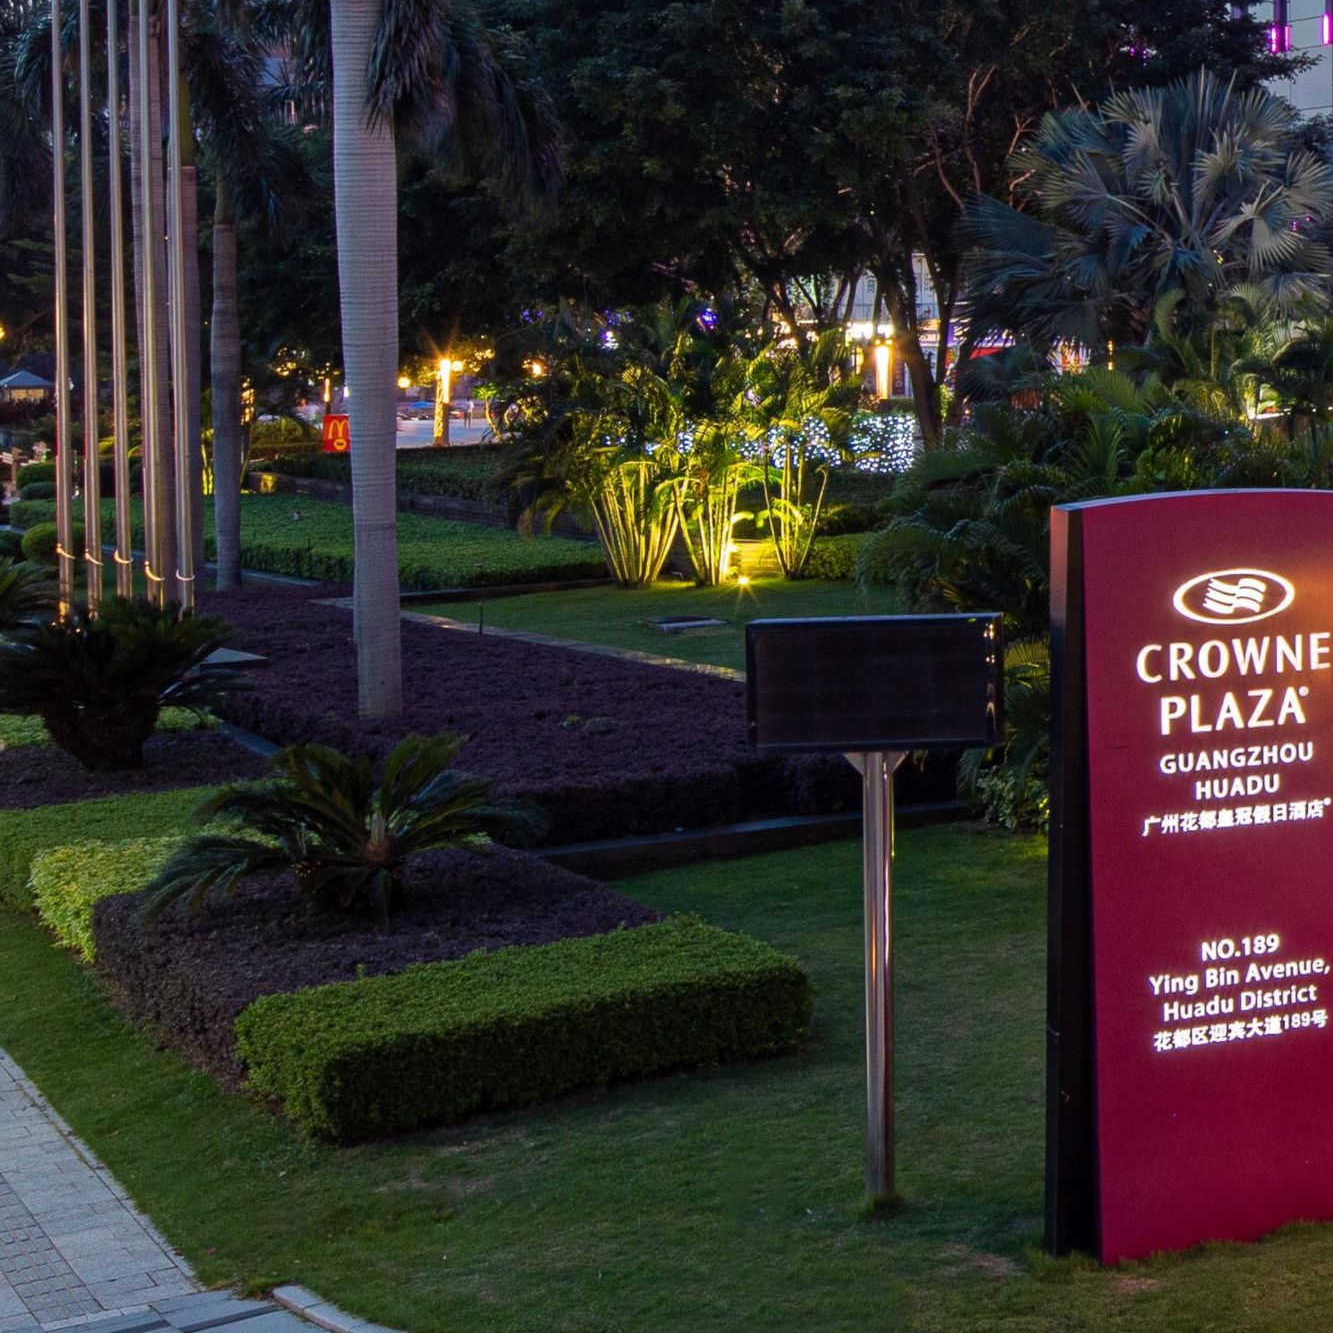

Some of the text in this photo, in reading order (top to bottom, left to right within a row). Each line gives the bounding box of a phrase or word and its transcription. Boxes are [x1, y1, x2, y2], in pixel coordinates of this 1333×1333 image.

[1136, 632, 1331, 683] CROWNE
[1159, 741, 1314, 774] GUANGZHOU
[1195, 773, 1280, 800] HUADU
[1142, 799, 1325, 837] 广州花都皇冠假日酒店
[1201, 933, 1281, 962] NO.189
[1149, 957, 1331, 996] Ying Bin Avenue,
[1163, 984, 1318, 1022] Huadu District
[1153, 1009, 1329, 1053] 花都区迎宾大道189号
